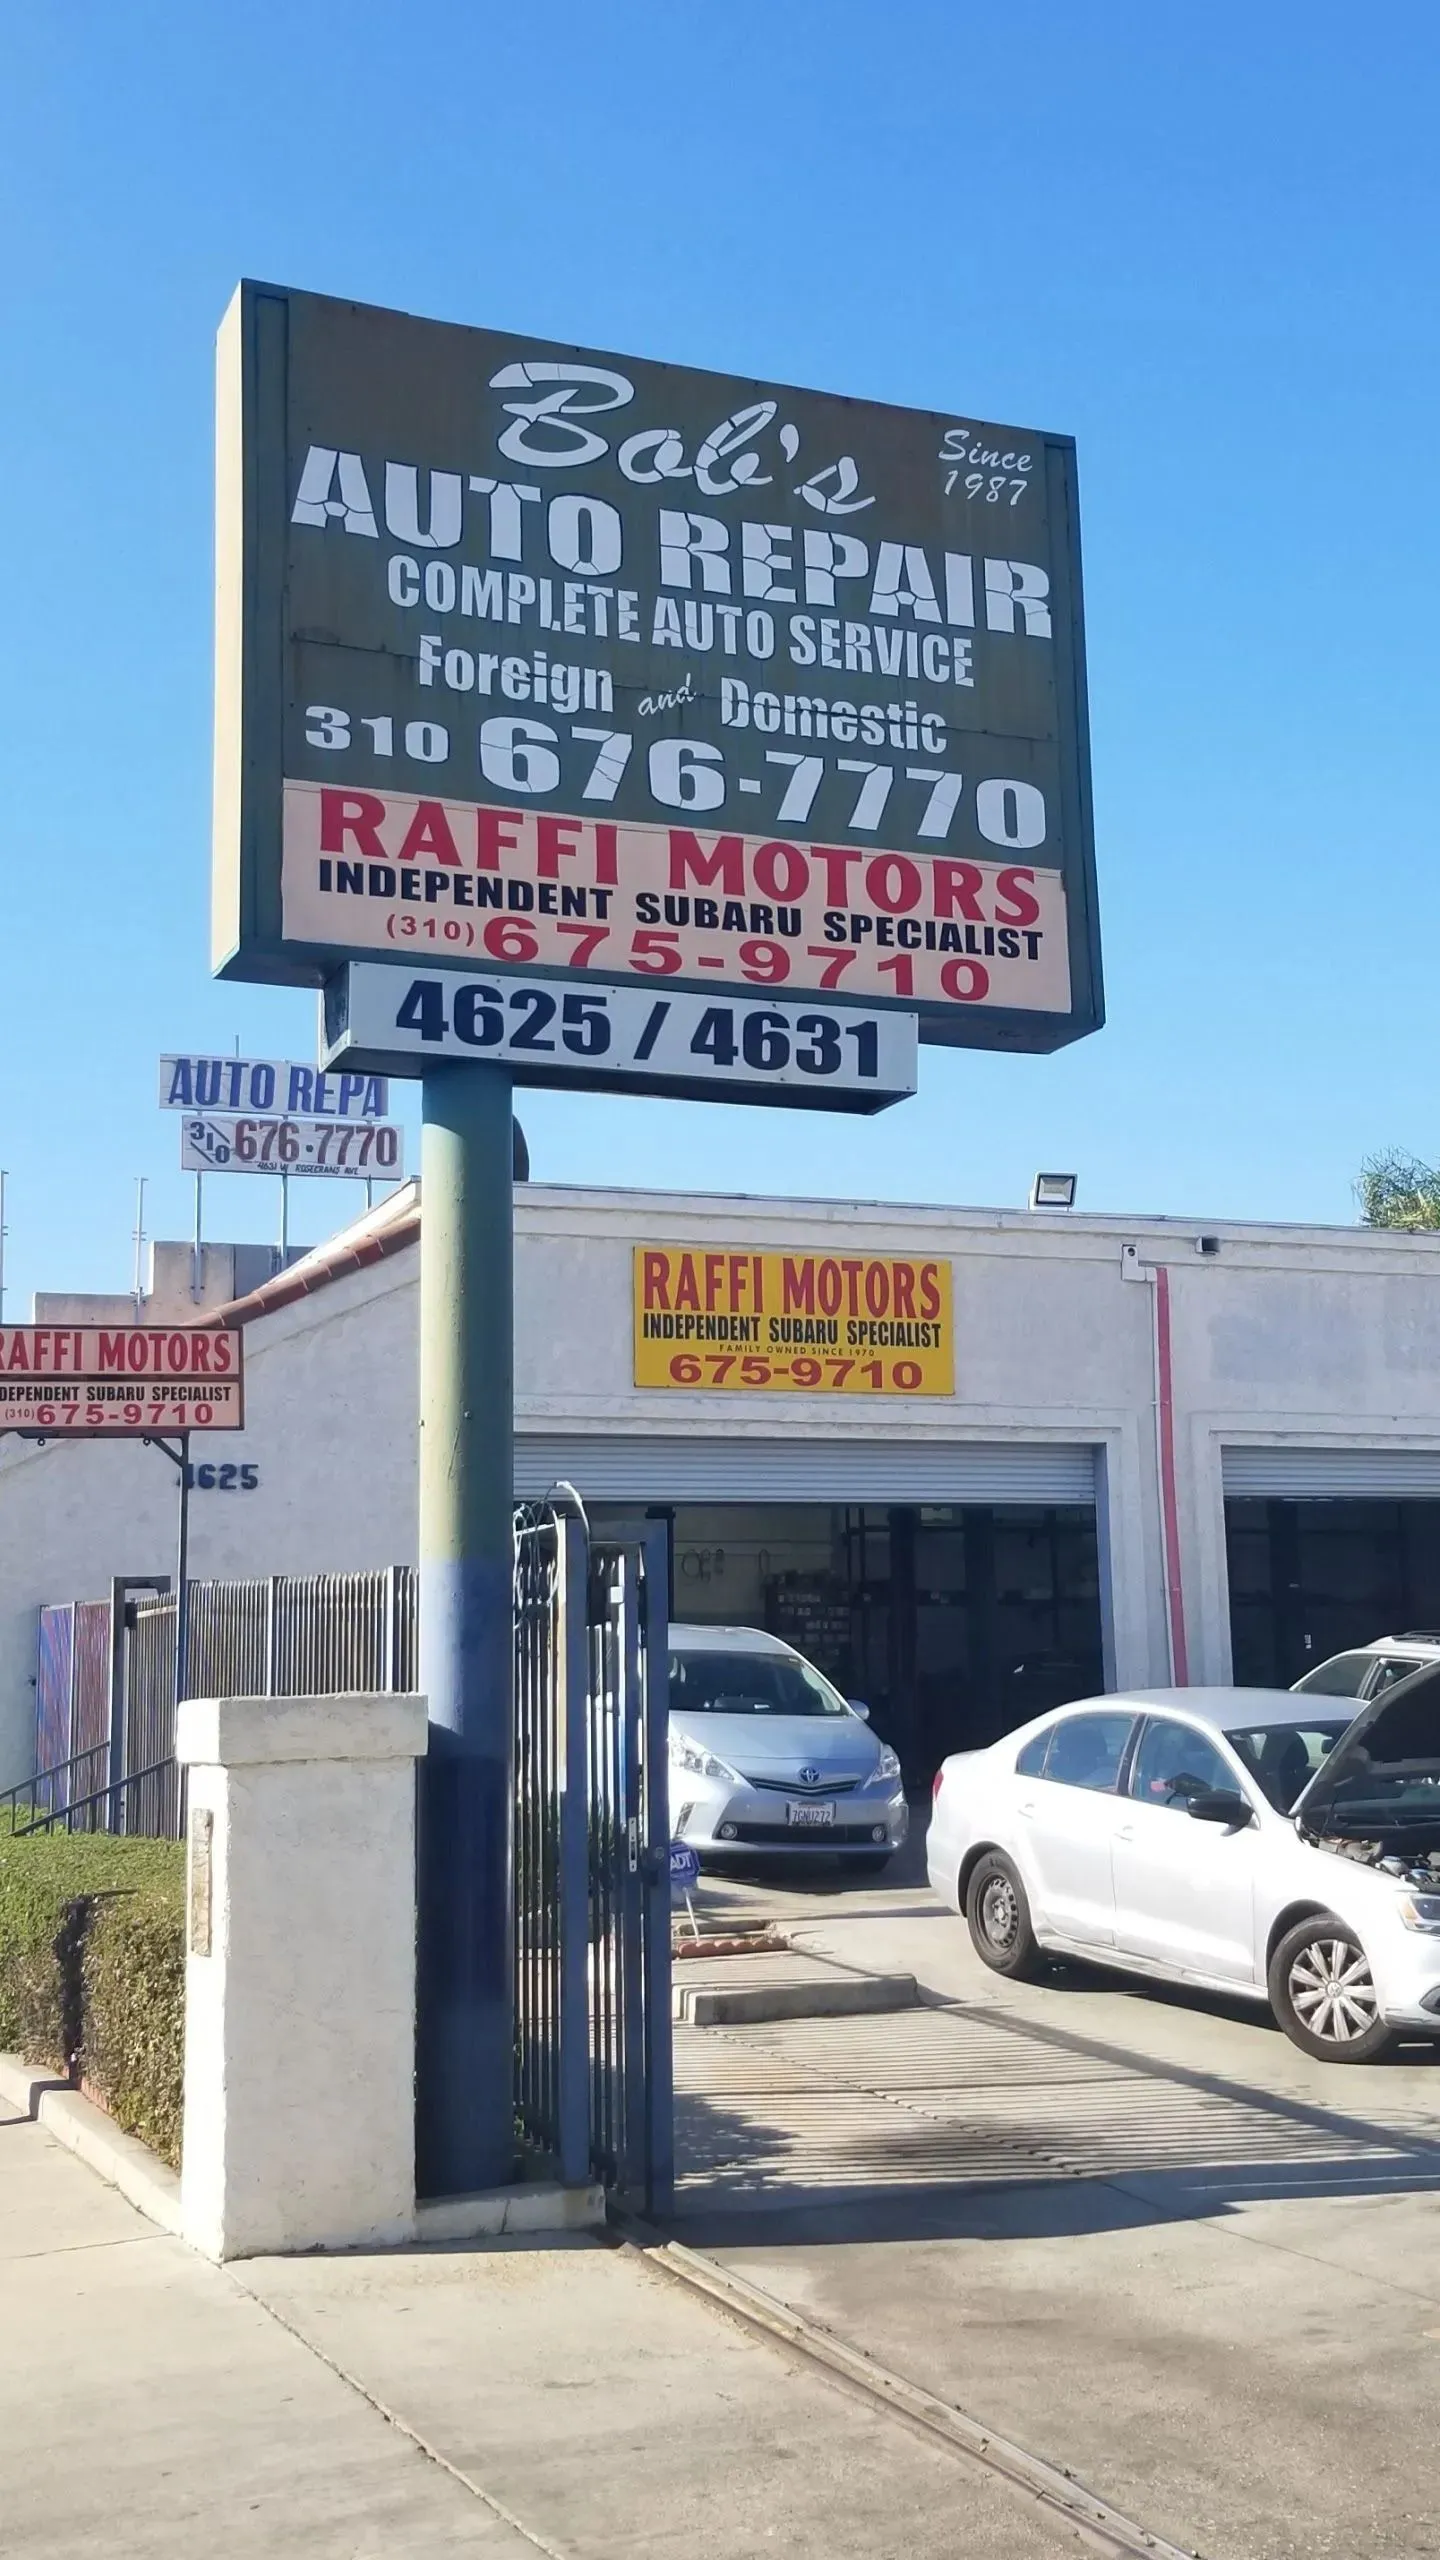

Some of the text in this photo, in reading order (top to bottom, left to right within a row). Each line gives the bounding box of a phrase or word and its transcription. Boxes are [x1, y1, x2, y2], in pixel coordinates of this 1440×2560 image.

[940, 429, 1034, 473] Since
[943, 469, 1029, 508] 1987
[291, 445, 1054, 640] AUTO REPAIR
[387, 554, 975, 689] COMPLETE AUTO SERVICE
[418, 635, 949, 755] Foreign and Domestic
[304, 705, 1048, 849] 310 676-7770
[319, 788, 1041, 928] RAFFI MOTORS
[319, 859, 1043, 962] INDEPENDENT SUBARU SPECIALIST
[386, 911, 992, 1003] (310) 675-9710
[396, 980, 880, 1079] 4625 / 4631
[168, 1059, 275, 1109] AUTO
[644, 1251, 941, 1320] RAFFI MOTORS
[0, 1331, 231, 1372] AFFI MOTORS
[643, 1312, 941, 1348] INDEPENDENT SUBARU SPECIALIST
[719, 1344, 875, 1357] FAMILY OWNED SINCE 1970
[86, 1386, 145, 1401] SUBARU
[152, 1386, 231, 1401] SPECIALIST
[669, 1353, 923, 1389] 675-9710
[5, 1403, 213, 1425] (310) 675-9710
